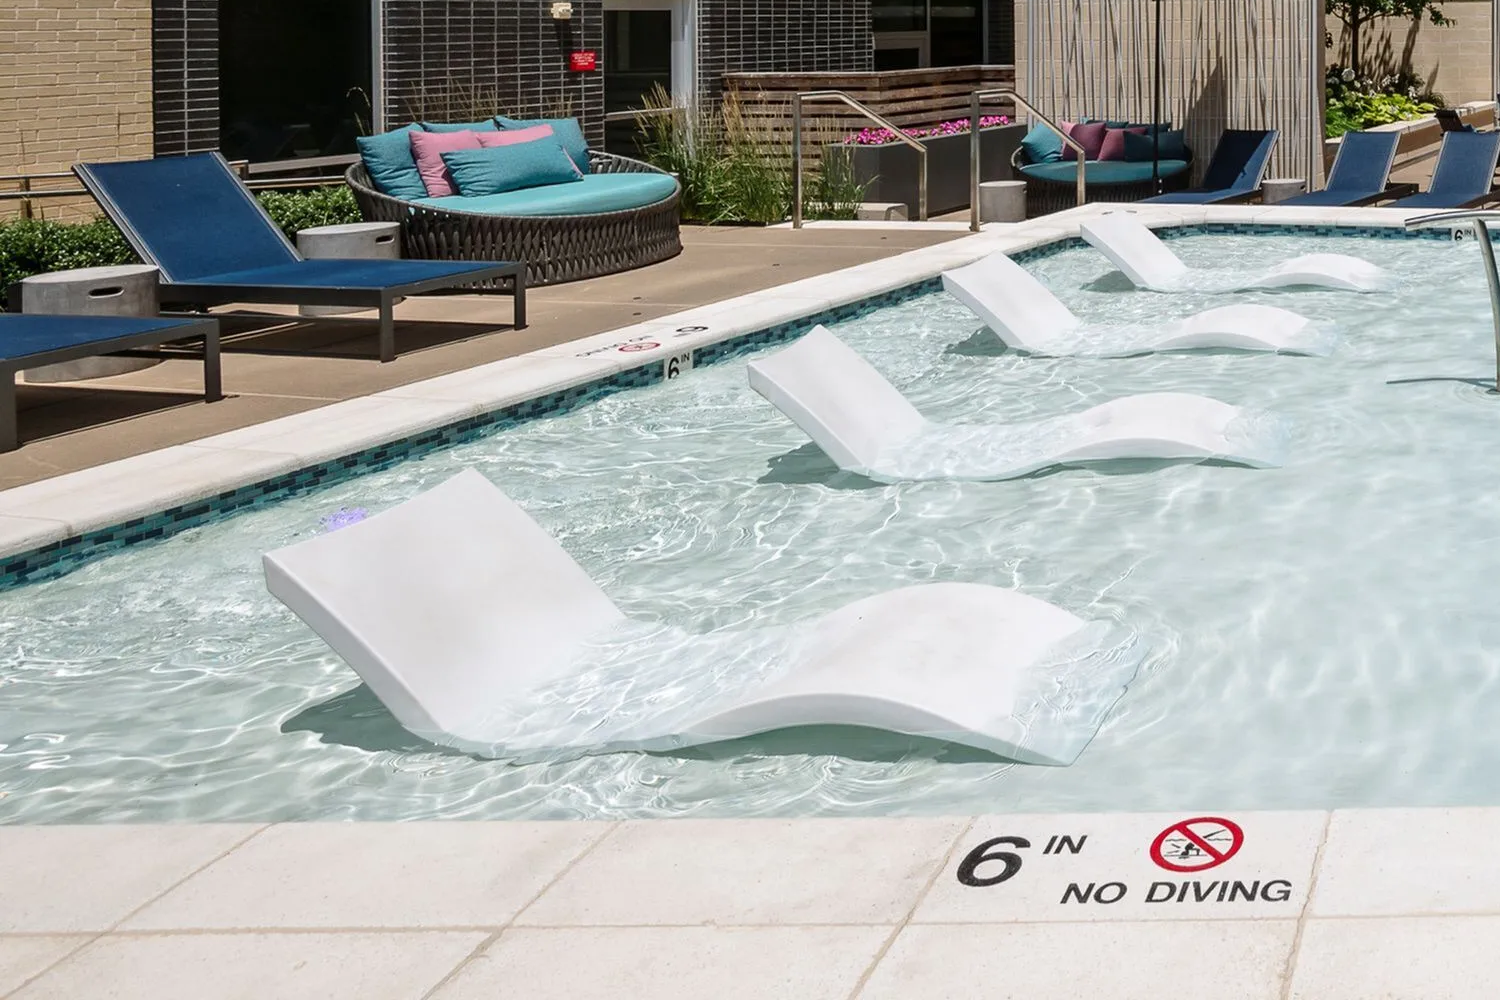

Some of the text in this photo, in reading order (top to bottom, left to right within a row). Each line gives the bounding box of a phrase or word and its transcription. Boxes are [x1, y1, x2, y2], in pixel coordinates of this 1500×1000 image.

[668, 352, 690, 379] 6 IN
[956, 834, 1088, 887] 6 IN
[1060, 879, 1293, 905] NO DIVING
